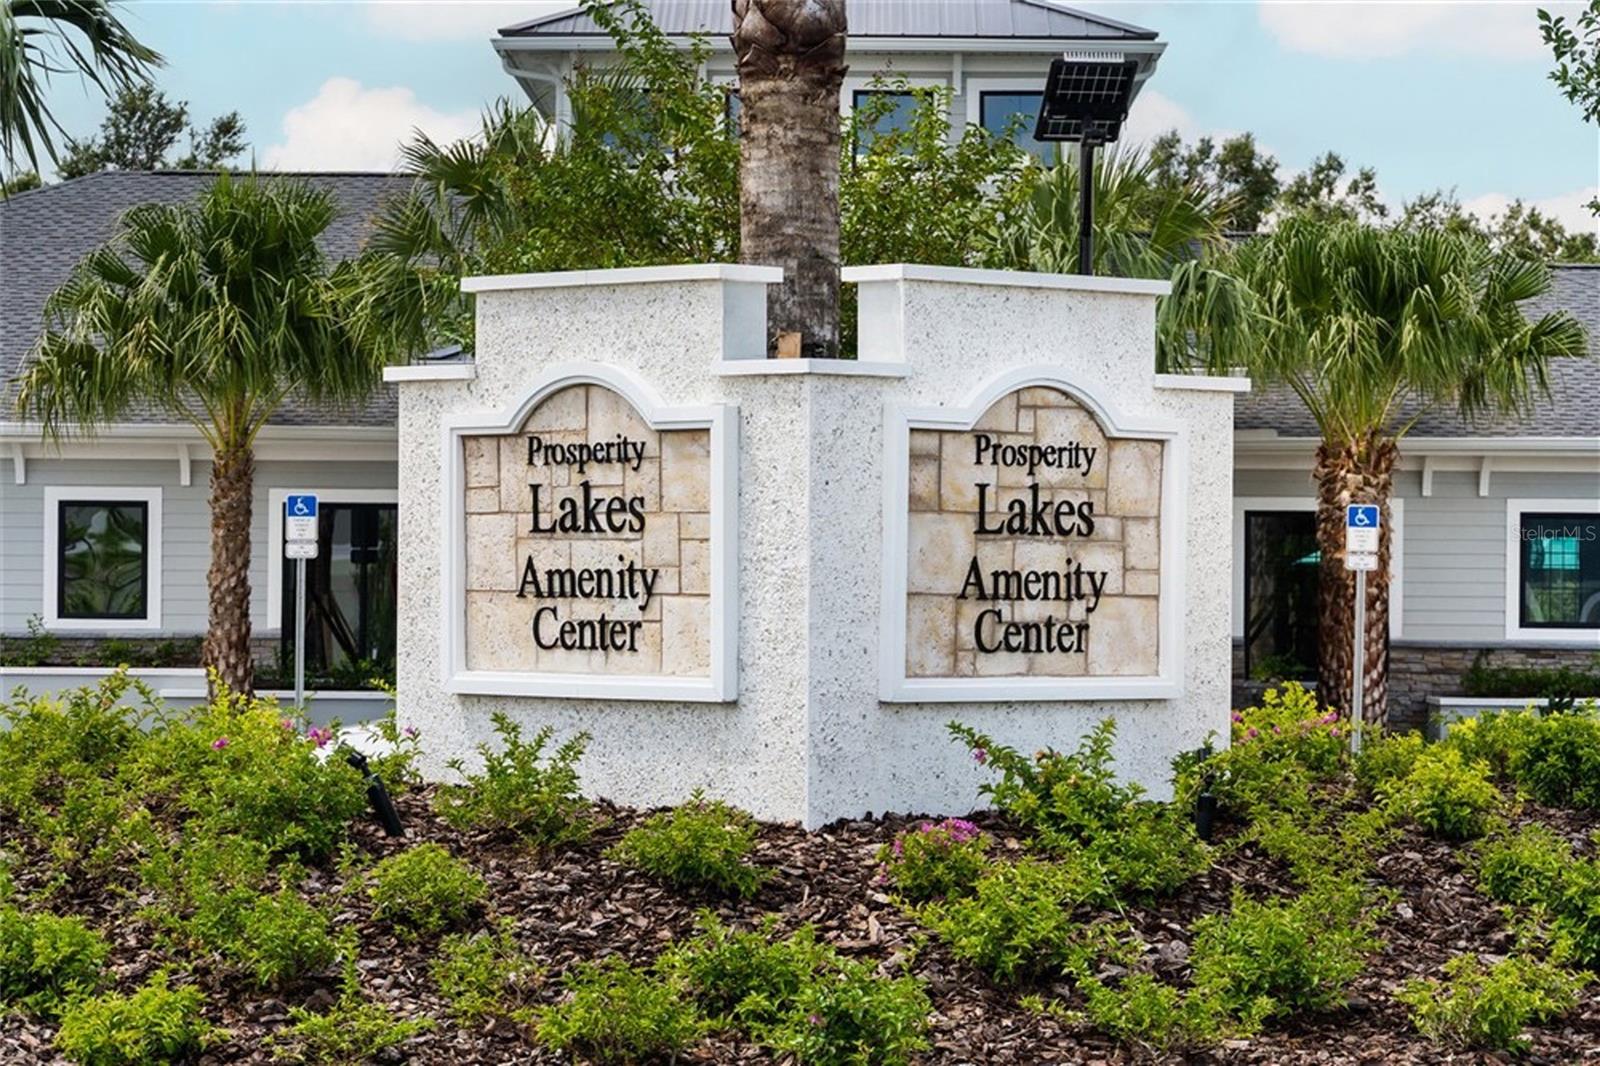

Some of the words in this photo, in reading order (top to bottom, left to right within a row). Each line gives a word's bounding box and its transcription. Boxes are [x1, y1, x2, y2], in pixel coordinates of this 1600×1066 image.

[526, 433, 646, 474] Prosperity
[974, 434, 1097, 476] Prosperity
[529, 480, 645, 534] Lakes
[974, 483, 1095, 537] Lakes
[516, 554, 659, 611] Amenity
[957, 556, 1108, 613] Amenity
[532, 606, 642, 652] Center
[974, 609, 1090, 654] Center
